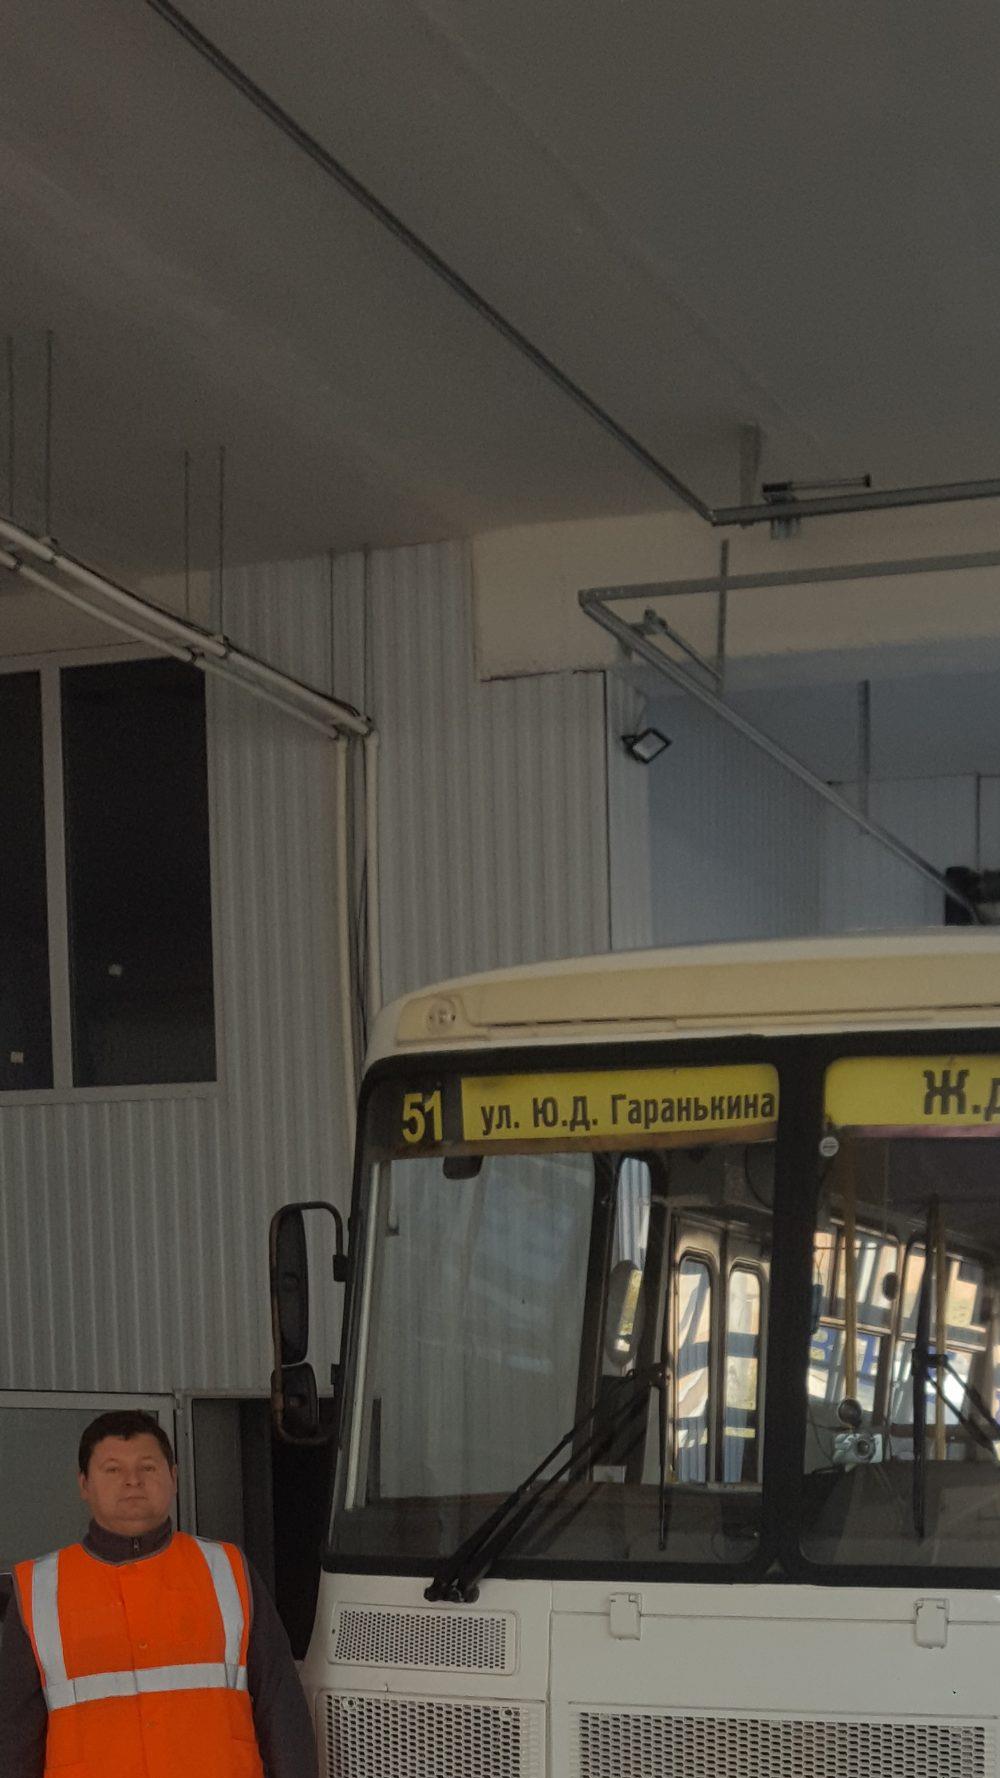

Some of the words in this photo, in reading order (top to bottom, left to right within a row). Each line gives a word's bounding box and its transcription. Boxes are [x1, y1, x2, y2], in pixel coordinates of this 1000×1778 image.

[402, 1089, 443, 1143] 51
[480, 1101, 520, 1136] ул.
[532, 1094, 599, 1132] Ю.Д.
[611, 1090, 776, 1132] Гаранькина
